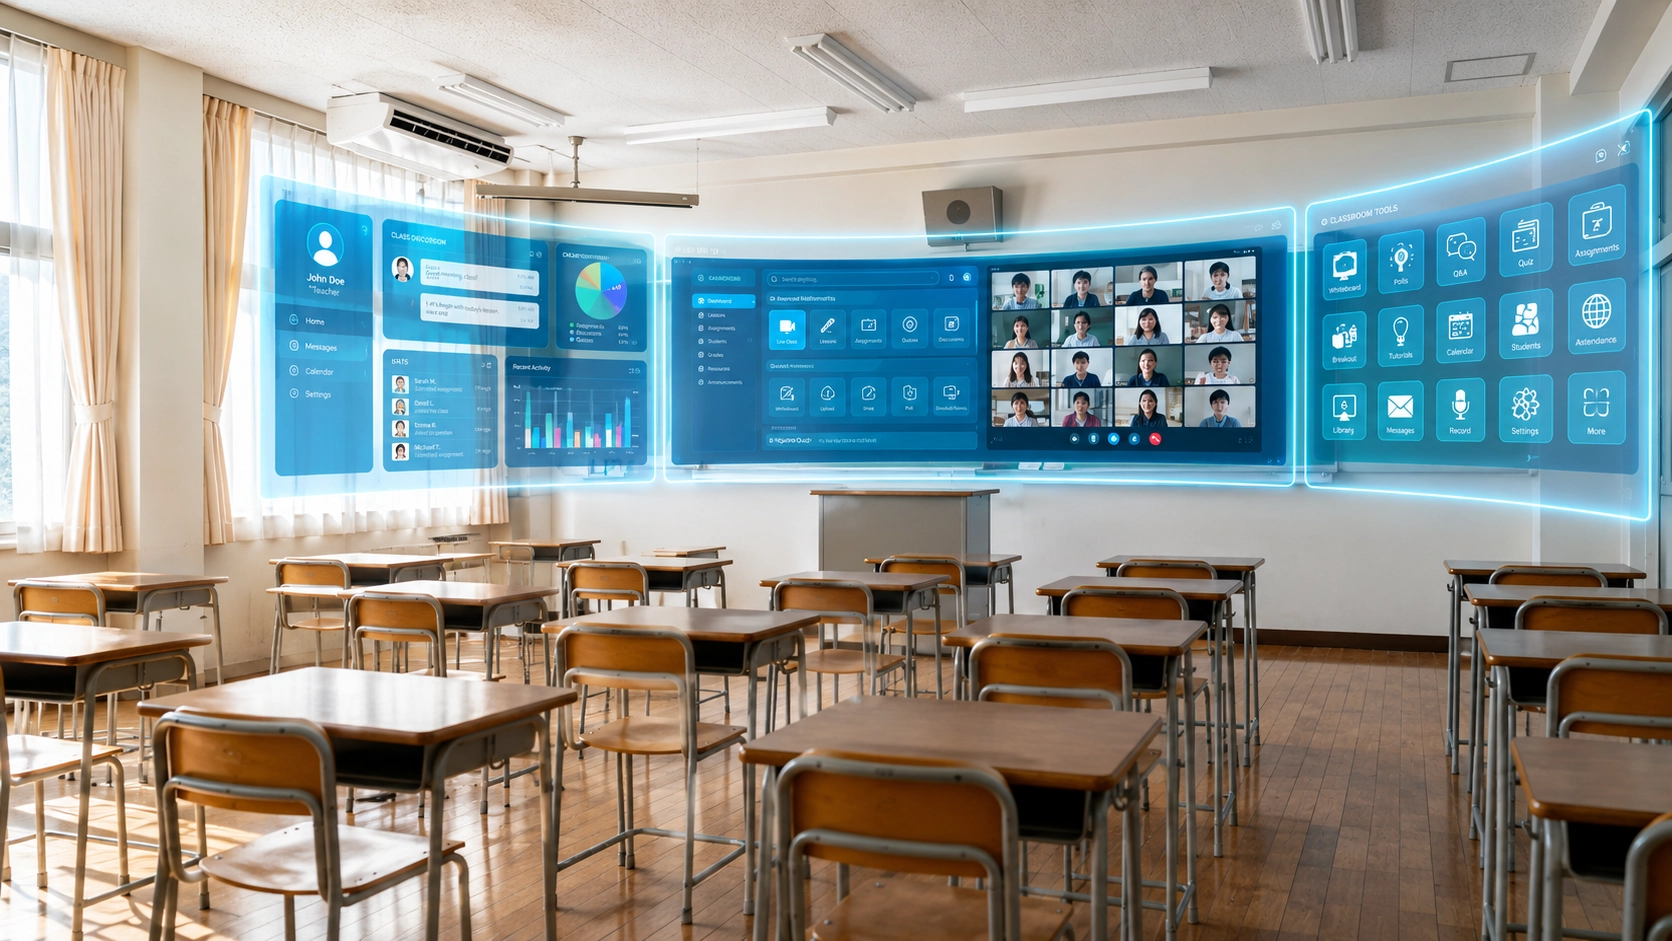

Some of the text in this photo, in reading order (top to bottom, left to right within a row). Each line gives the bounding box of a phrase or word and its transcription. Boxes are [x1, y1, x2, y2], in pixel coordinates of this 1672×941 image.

[1374, 204, 1398, 216] TOOLS
[1518, 258, 1534, 268] Quiz
[306, 273, 345, 286] John Doe
[305, 317, 325, 326] Home
[1446, 348, 1474, 356] Calendar
[1449, 427, 1471, 435] Record
[1511, 427, 1539, 436] Settings
[1587, 427, 1606, 436] More
